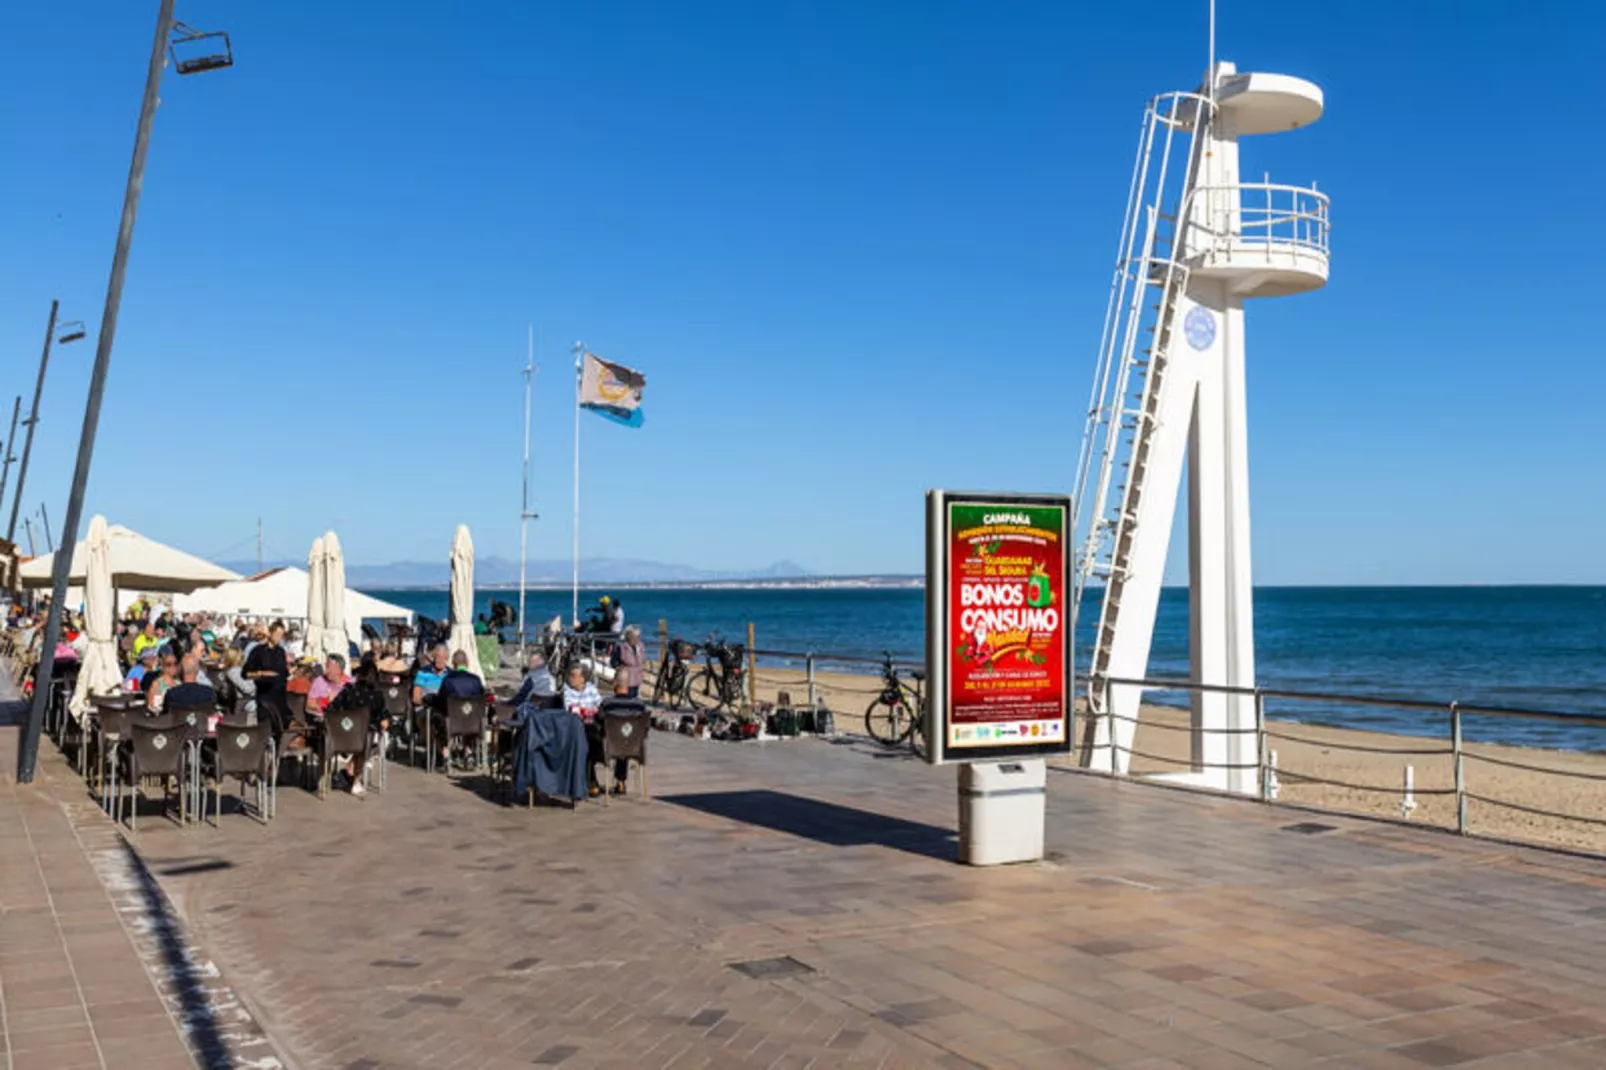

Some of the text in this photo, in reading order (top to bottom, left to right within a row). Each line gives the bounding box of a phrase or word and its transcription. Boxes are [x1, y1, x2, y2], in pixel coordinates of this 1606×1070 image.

[983, 511, 1031, 526] CAMPAÑA
[961, 583, 1024, 606] BONOS
[961, 608, 1058, 633] CONSUMO
